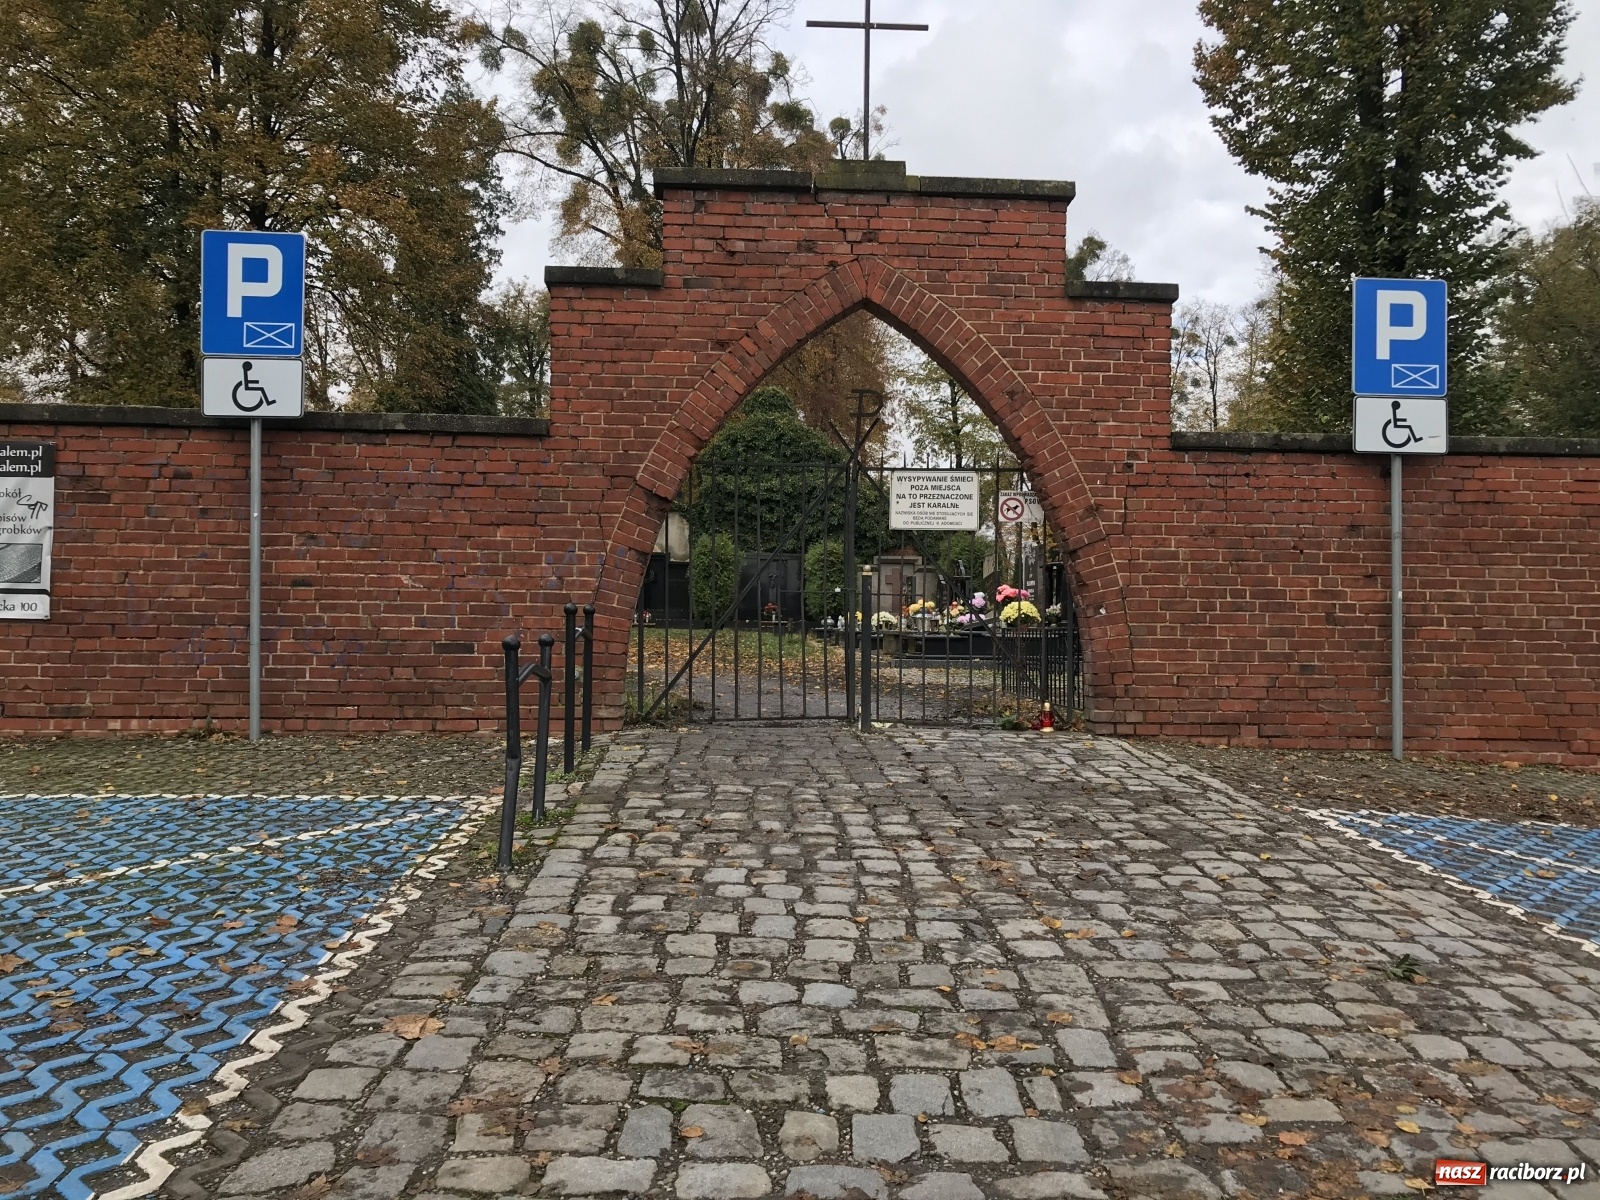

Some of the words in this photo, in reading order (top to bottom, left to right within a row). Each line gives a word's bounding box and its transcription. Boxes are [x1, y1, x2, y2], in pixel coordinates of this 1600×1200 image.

[227, 243, 283, 318] P
[1376, 290, 1427, 360] P
[0, 445, 43, 460] alem.pl
[0, 459, 42, 476] alem.pl
[949, 474, 974, 482] ŚMIECI
[0, 513, 27, 522] isów
[20, 602, 38, 612] 100
